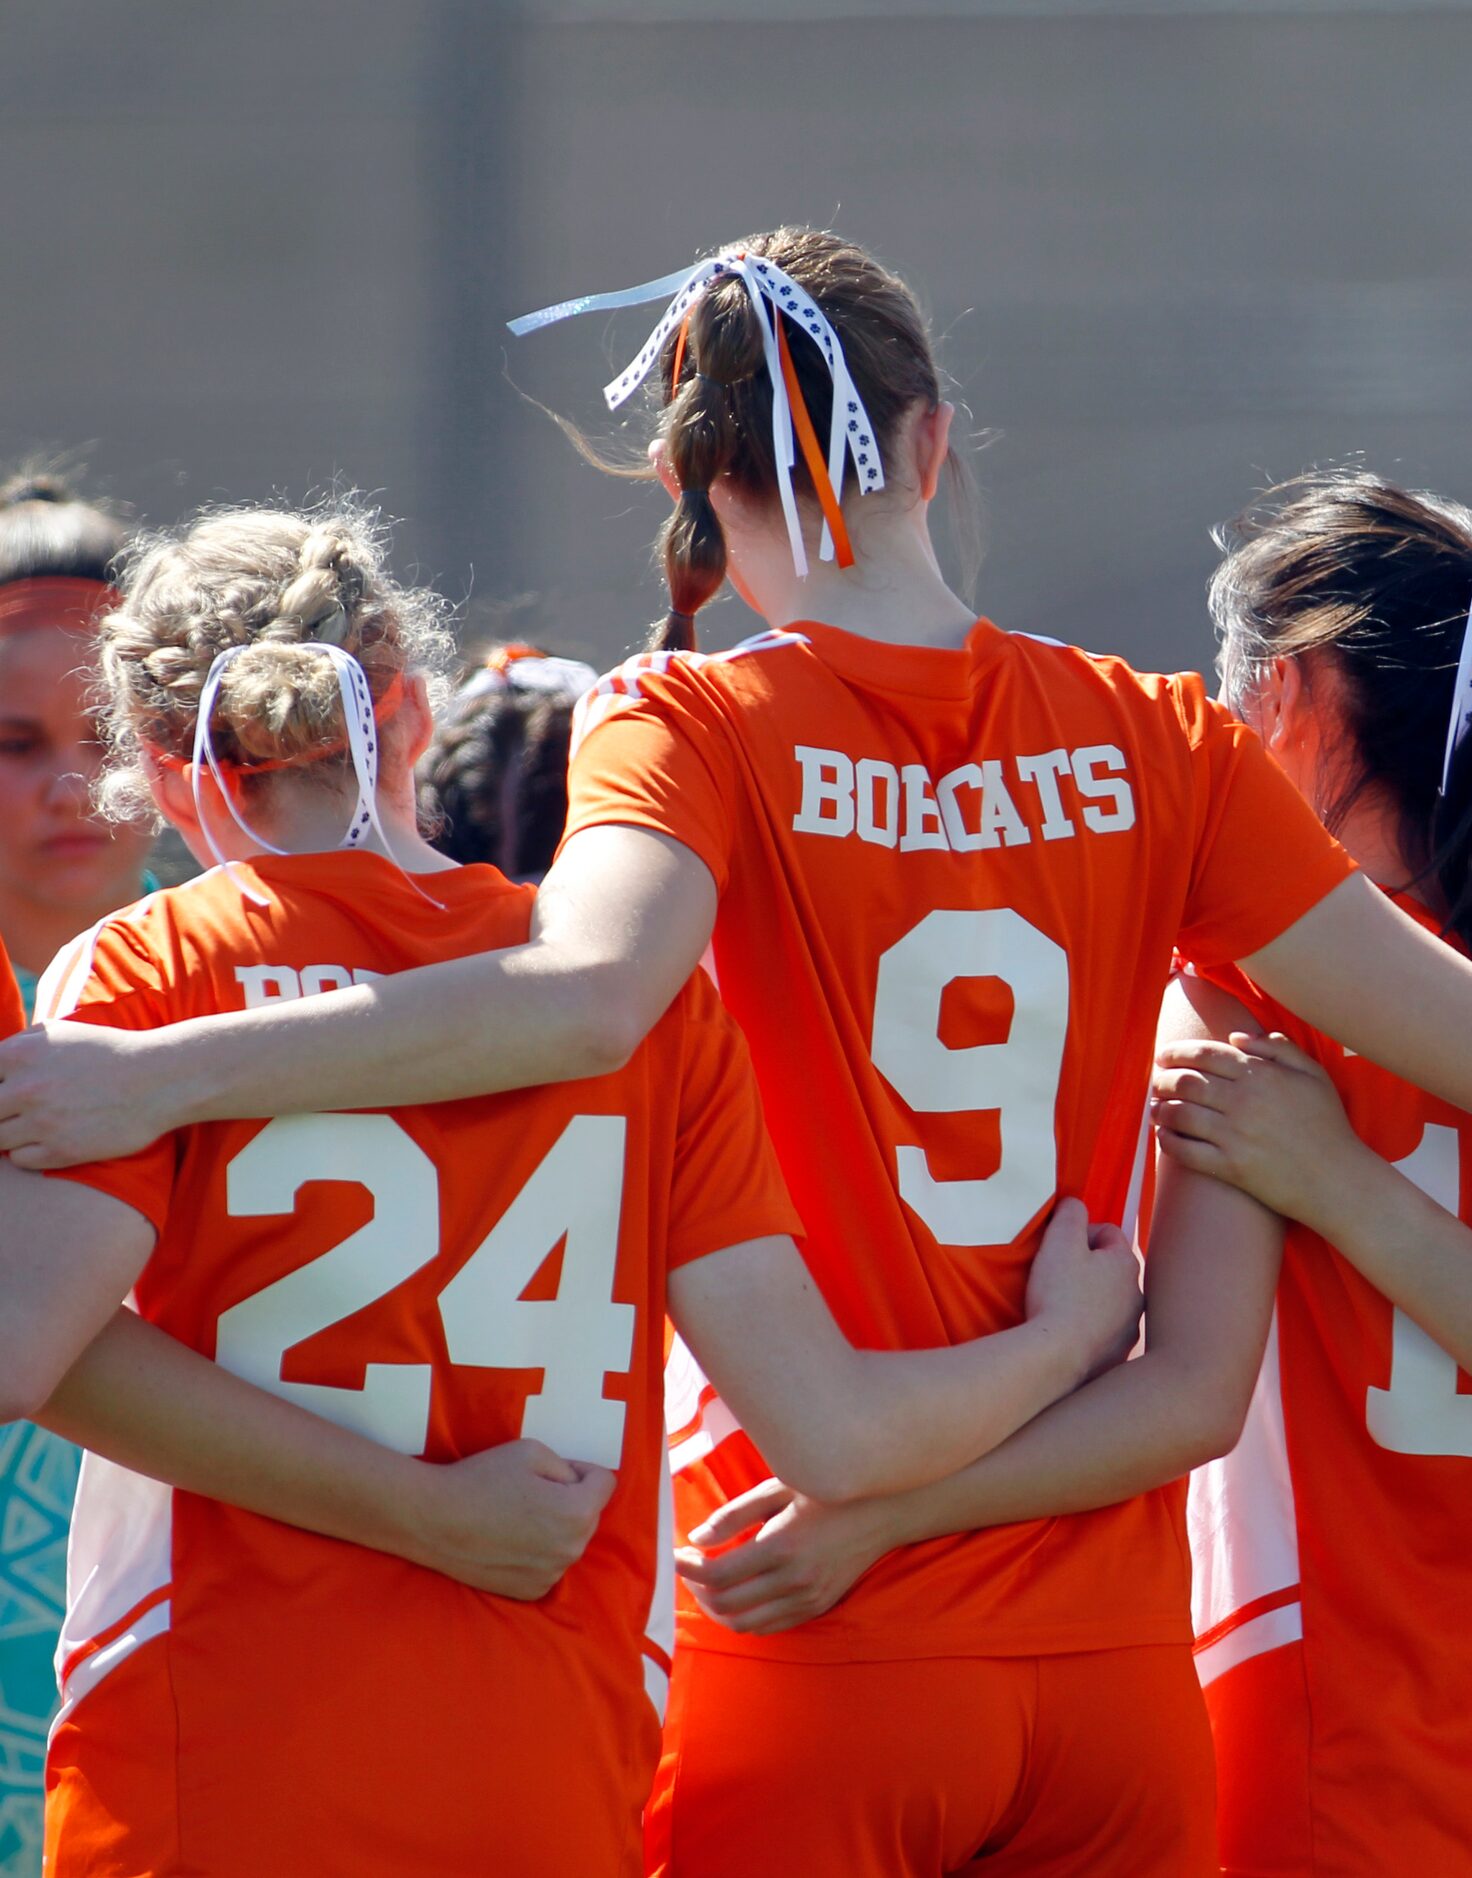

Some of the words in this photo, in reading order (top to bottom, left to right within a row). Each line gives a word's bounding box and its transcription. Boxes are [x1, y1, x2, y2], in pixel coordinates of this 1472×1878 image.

[792, 744, 1136, 853] BOBCATS
[871, 907, 1070, 1246] 9
[214, 1111, 636, 1470] 24
